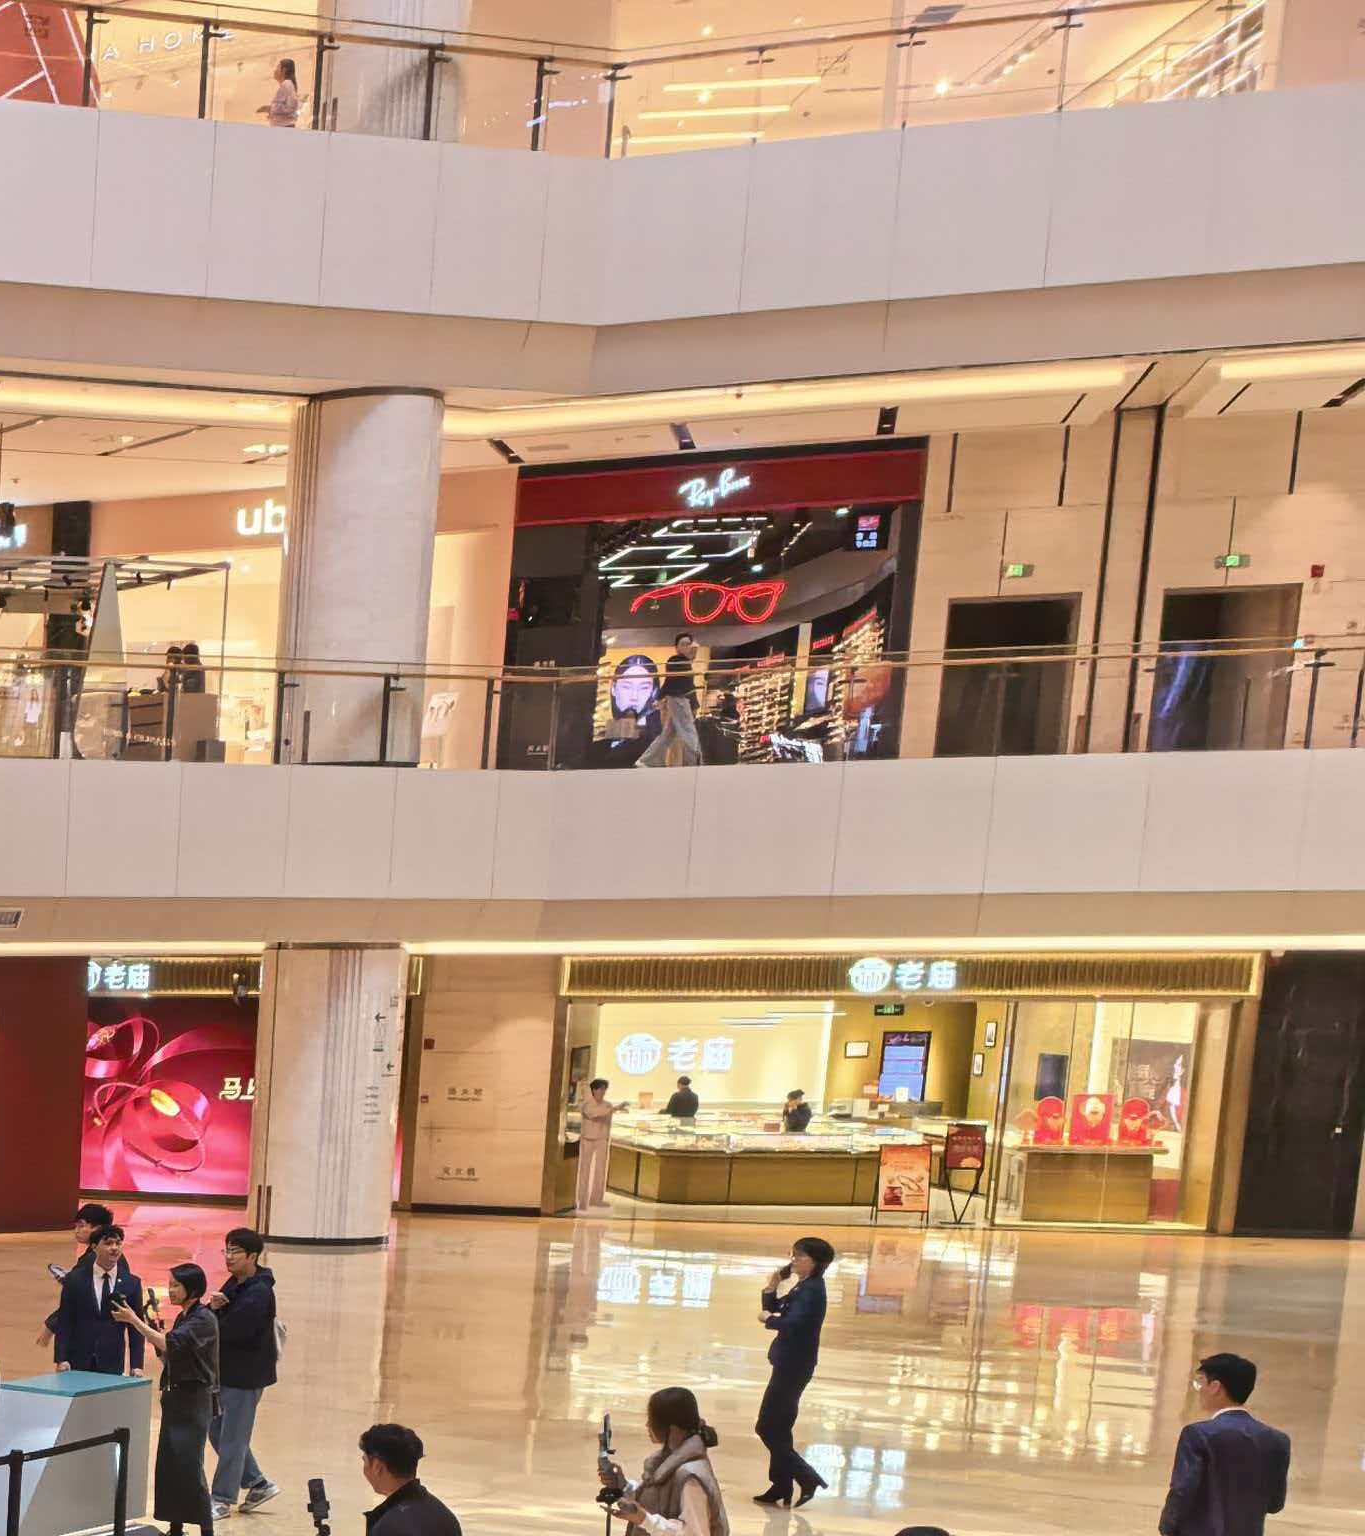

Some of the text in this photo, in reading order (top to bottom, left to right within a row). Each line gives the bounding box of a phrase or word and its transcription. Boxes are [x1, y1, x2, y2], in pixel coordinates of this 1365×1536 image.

[104, 961, 151, 990] 老庙
[895, 960, 958, 991] 老庙
[666, 1036, 736, 1073] 老庙
